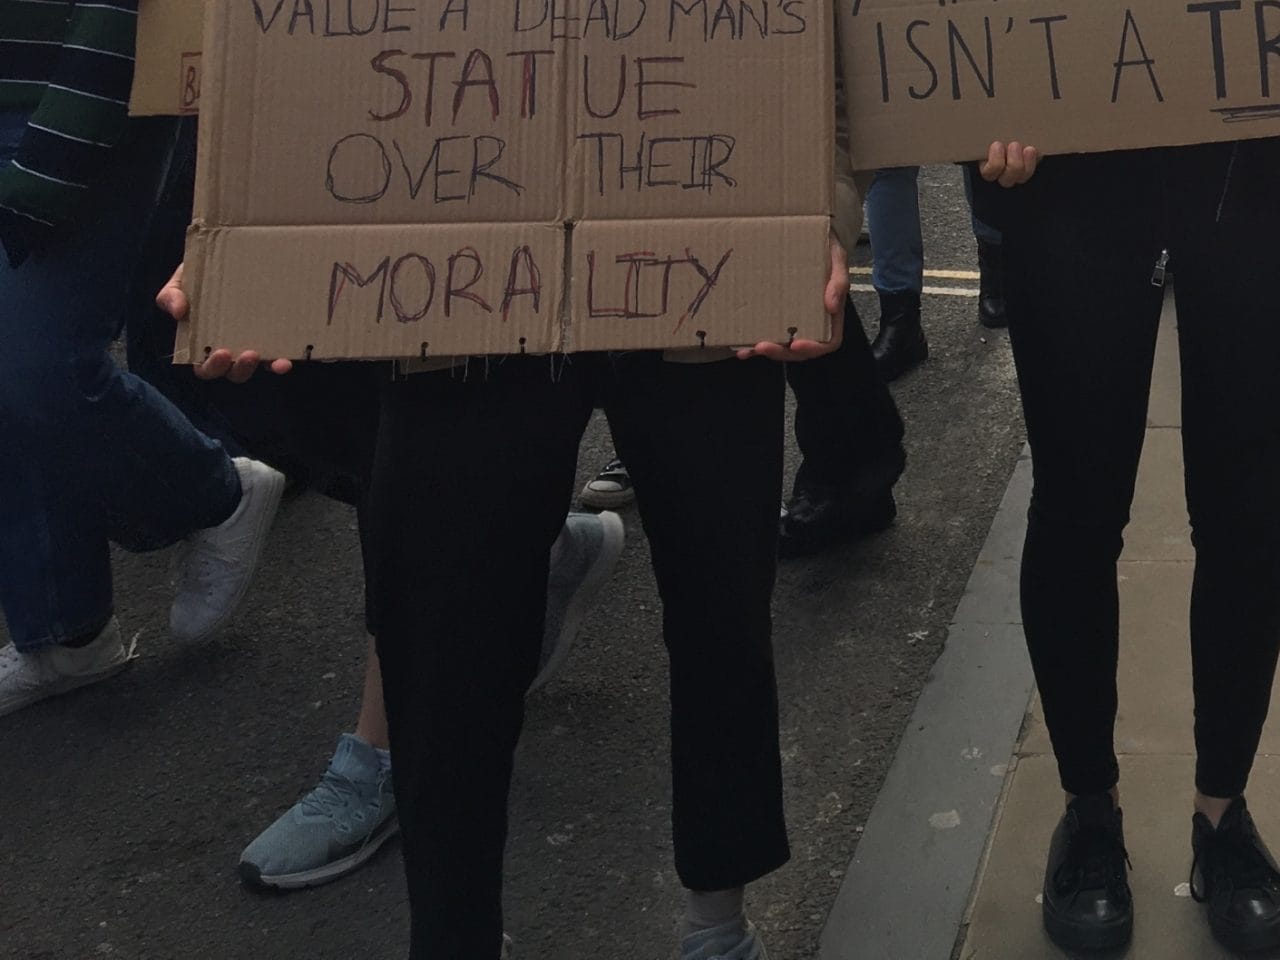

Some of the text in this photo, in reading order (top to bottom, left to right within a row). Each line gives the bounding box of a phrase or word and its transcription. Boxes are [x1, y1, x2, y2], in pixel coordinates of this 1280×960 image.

[367, 48, 697, 126] STATUE
[876, 14, 1069, 103] ISN'T
[1111, 9, 1165, 104] A
[325, 132, 738, 204] OVER THEIR
[326, 246, 735, 335] MORALITY
